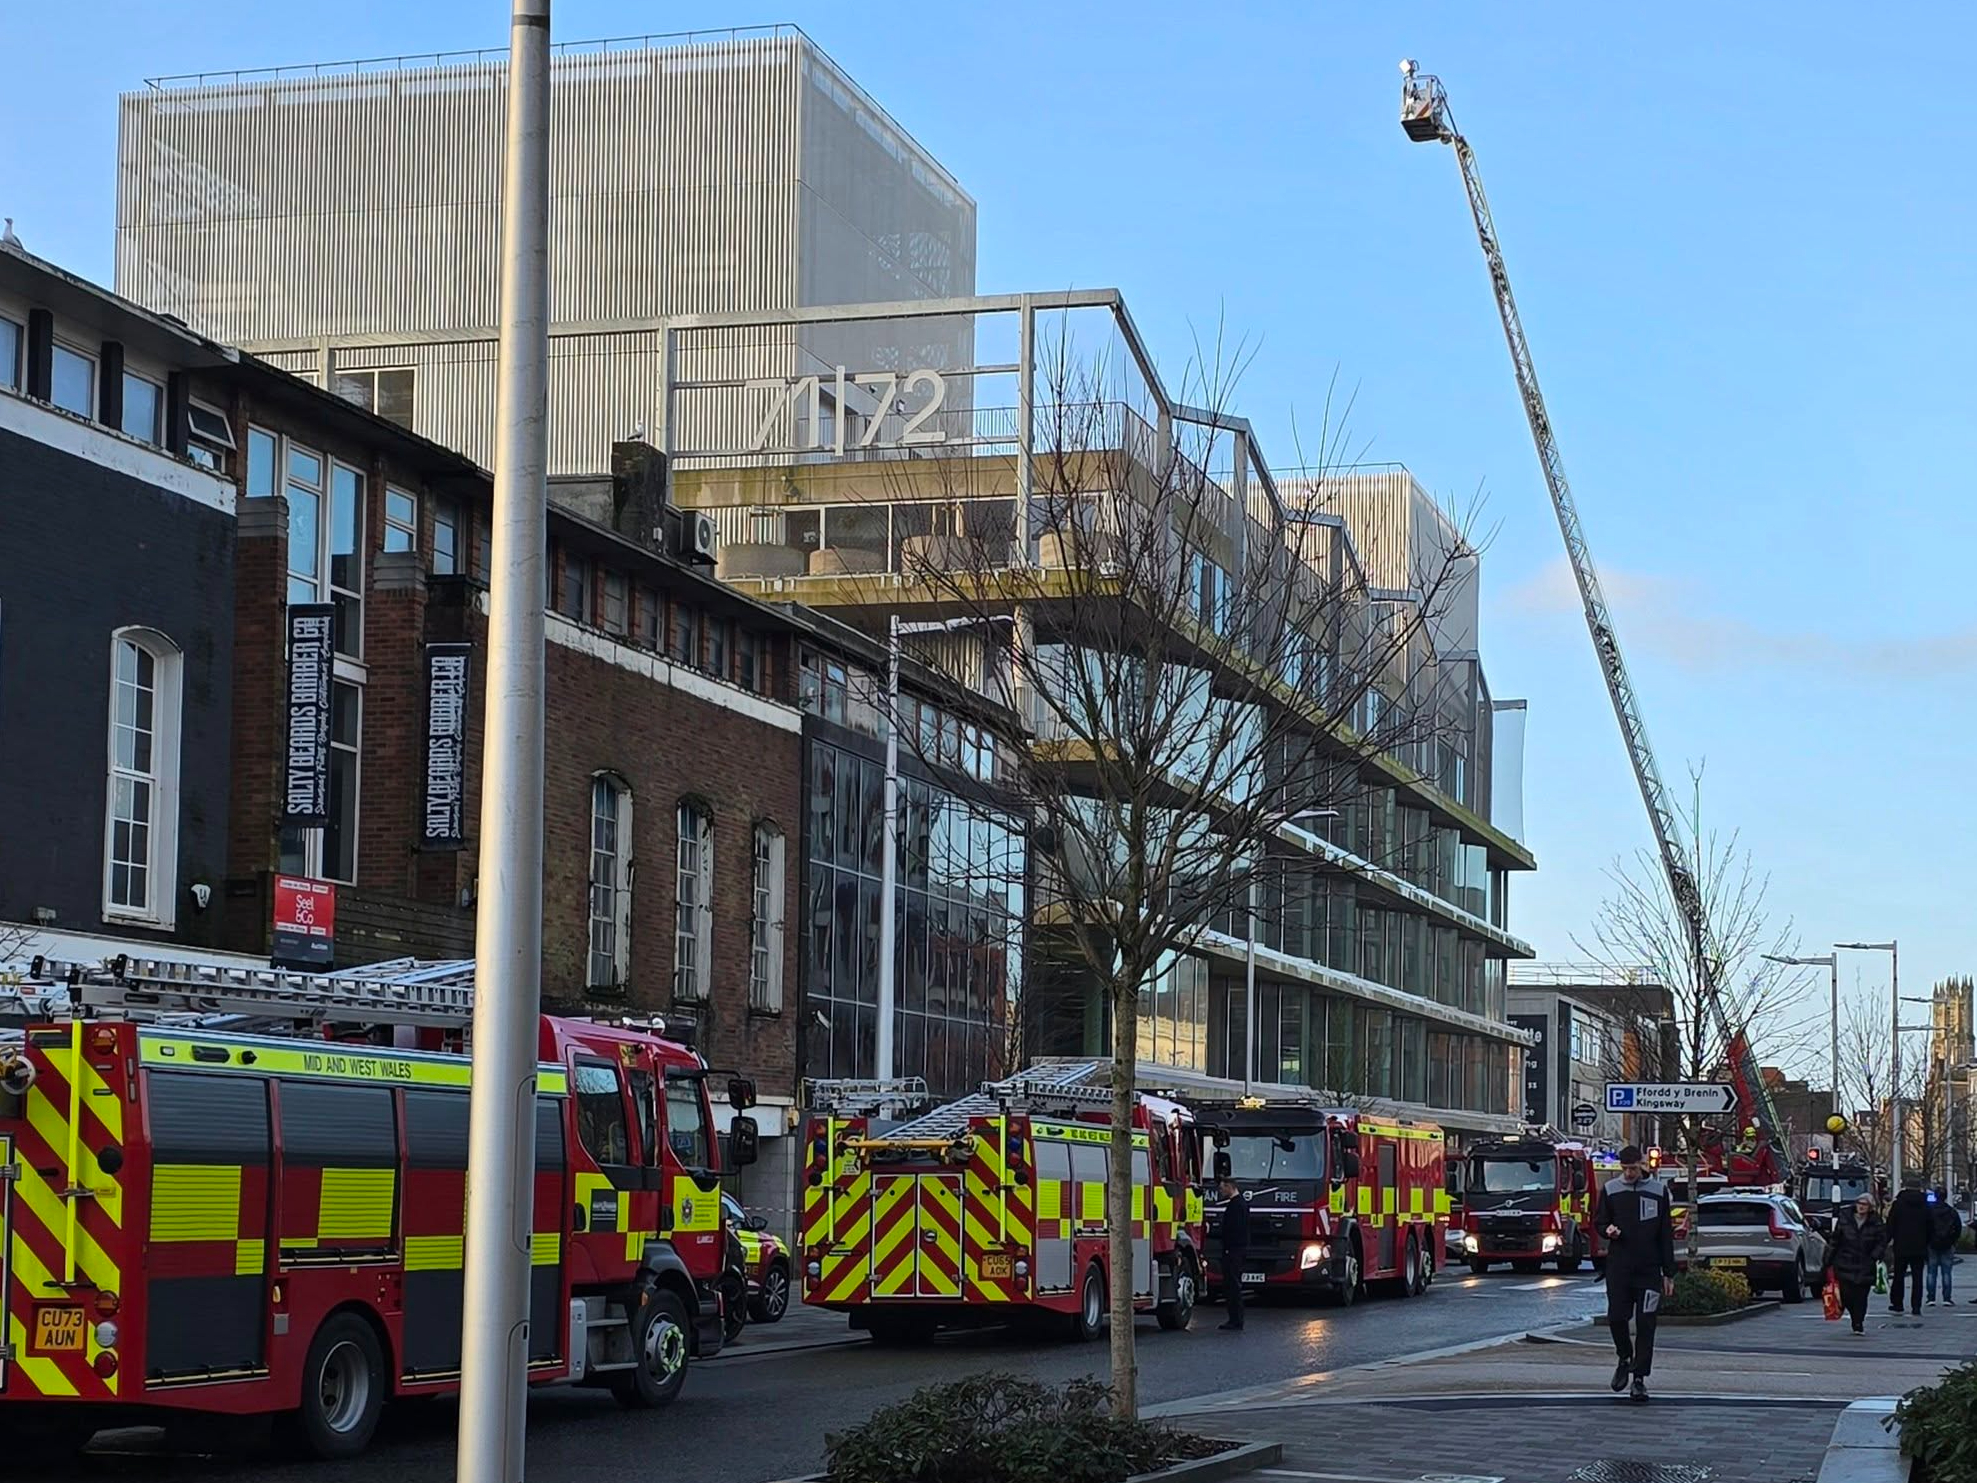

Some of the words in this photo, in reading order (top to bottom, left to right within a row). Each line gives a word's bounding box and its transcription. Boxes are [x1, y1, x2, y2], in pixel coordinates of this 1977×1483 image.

[291, 641, 320, 703] BARBER
[429, 680, 456, 736] BARBER
[289, 705, 318, 767] BEARDS
[428, 738, 454, 795] BEARDS
[287, 768, 315, 815] SALTY
[425, 797, 450, 838] SALTY
[296, 894, 315, 911] Seel
[303, 1054, 322, 1072] MID
[326, 1057, 346, 1074] AND
[349, 1058, 377, 1076] WEST
[380, 1061, 412, 1079] WALES
[1612, 1090, 1625, 1106] P
[1636, 1087, 1671, 1097] Ffordd
[1673, 1088, 1680, 1098] y
[1684, 1088, 1719, 1098] Brenin
[1636, 1098, 1686, 1109] Kingsway
[1275, 1191, 1298, 1203] FIRE
[42, 1310, 83, 1327] CU73
[44, 1329, 76, 1346] AUN
